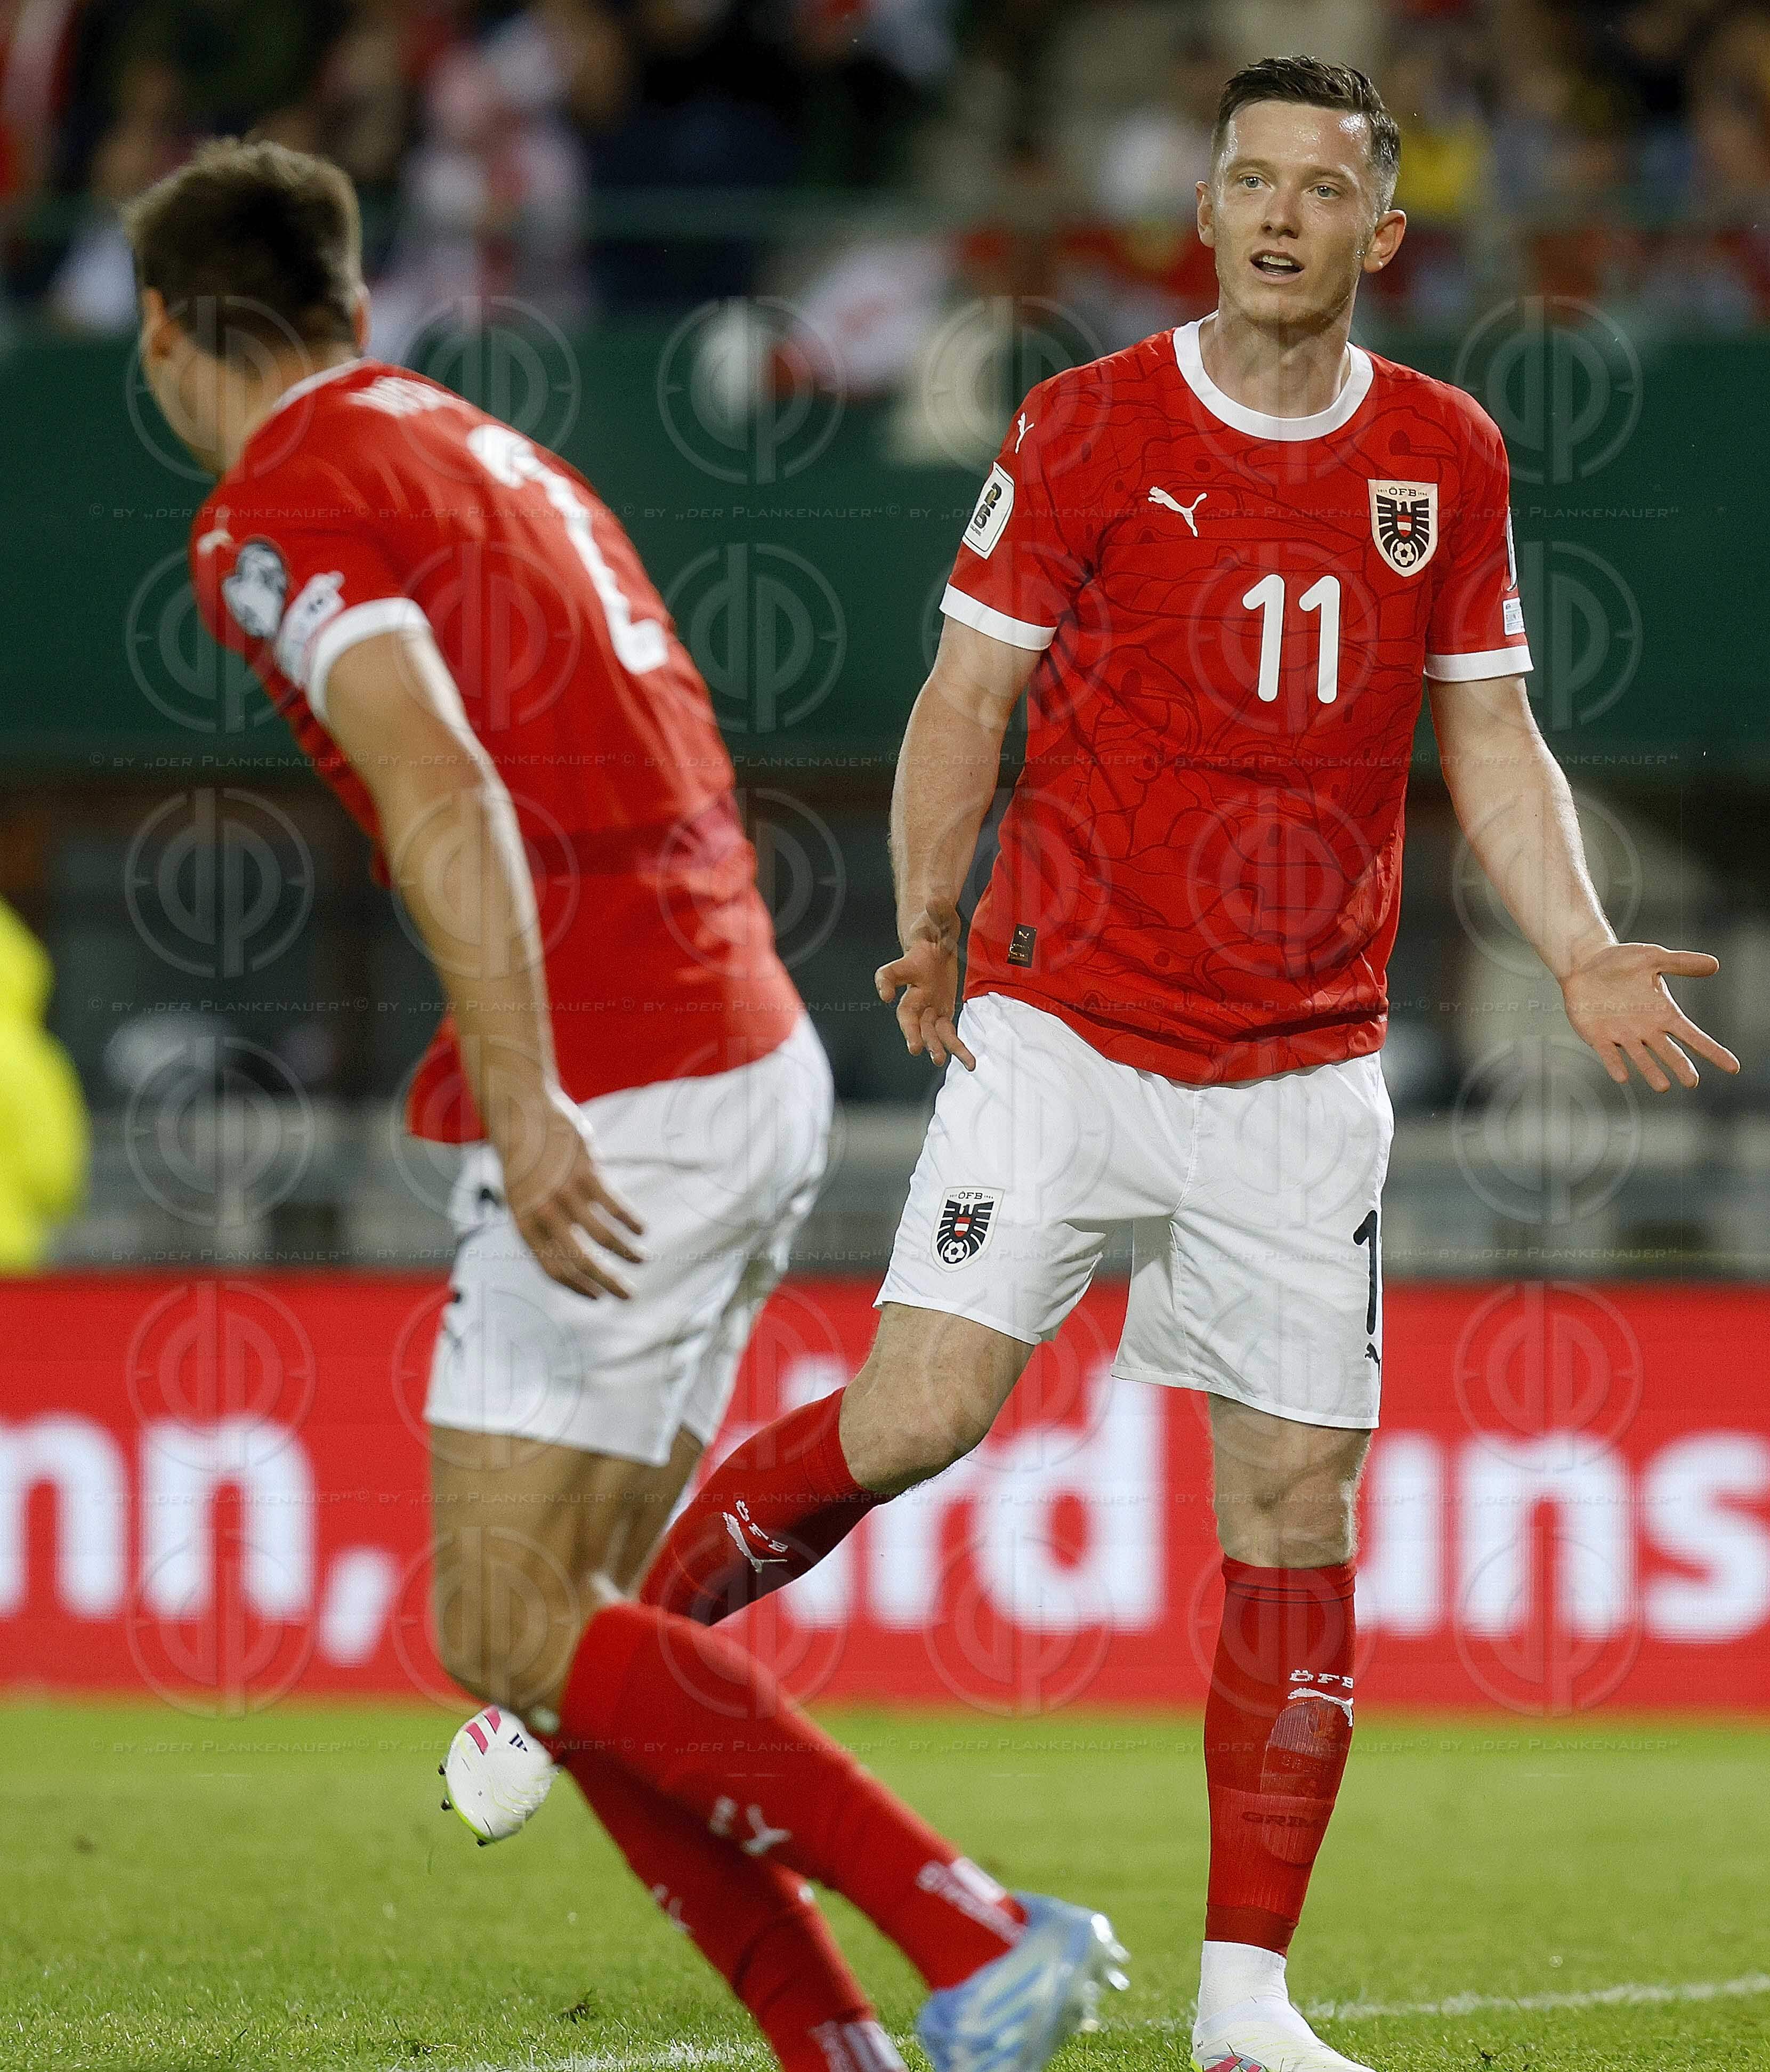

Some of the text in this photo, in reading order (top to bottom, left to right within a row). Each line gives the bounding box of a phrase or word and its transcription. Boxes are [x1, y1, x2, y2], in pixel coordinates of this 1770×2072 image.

[1389, 486, 1417, 497] ÖFB
[1242, 574, 1341, 704] 11
[958, 1191, 983, 1200] ÖFB
[1289, 1670, 1354, 1689] ÖFB
